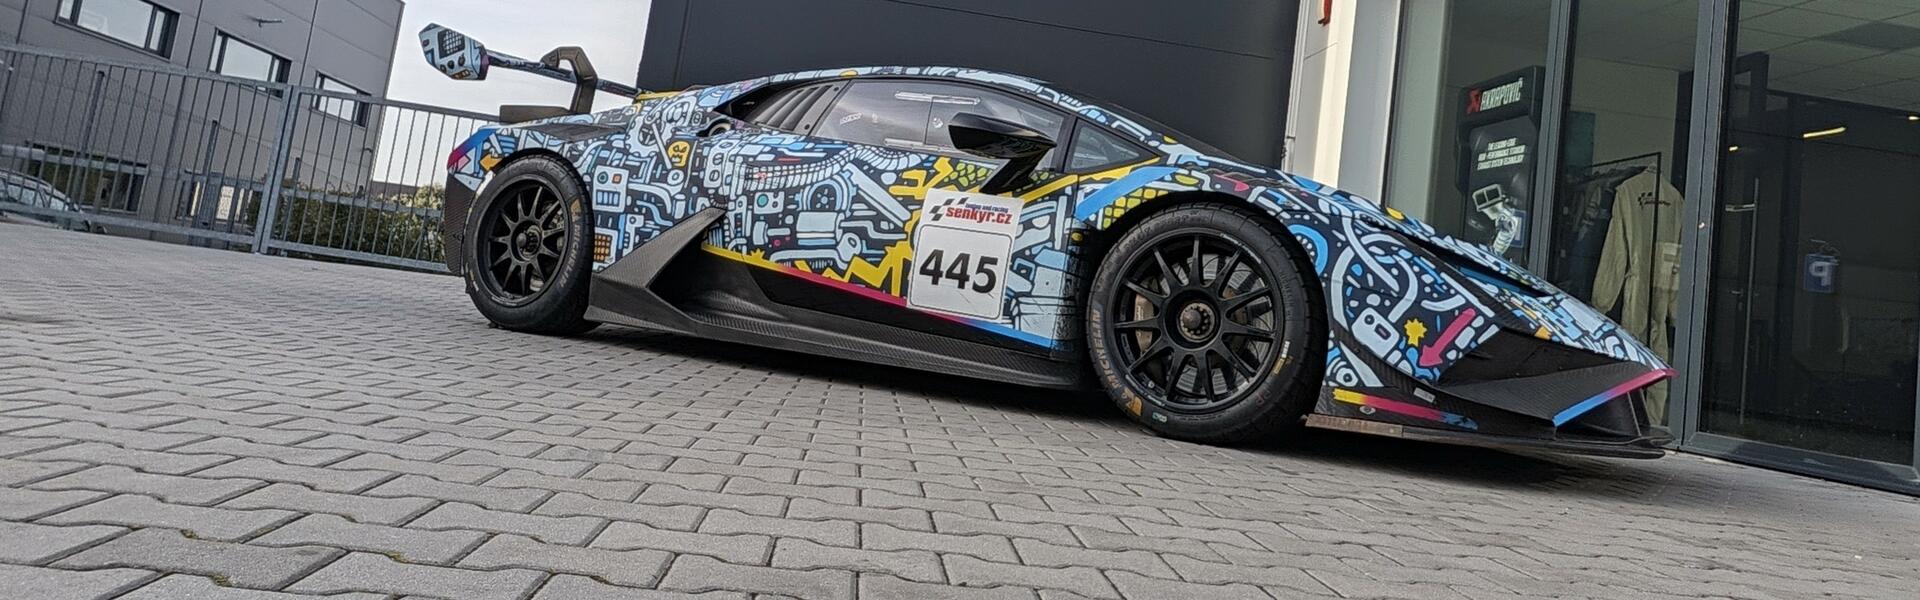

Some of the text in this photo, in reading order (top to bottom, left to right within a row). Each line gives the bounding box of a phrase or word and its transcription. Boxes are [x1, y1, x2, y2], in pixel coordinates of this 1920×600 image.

[945, 207, 1013, 224] senkyr.cz
[560, 224, 580, 287] MICHELIN
[919, 249, 998, 294] 445
[1092, 309, 1121, 389] MICHELIN
